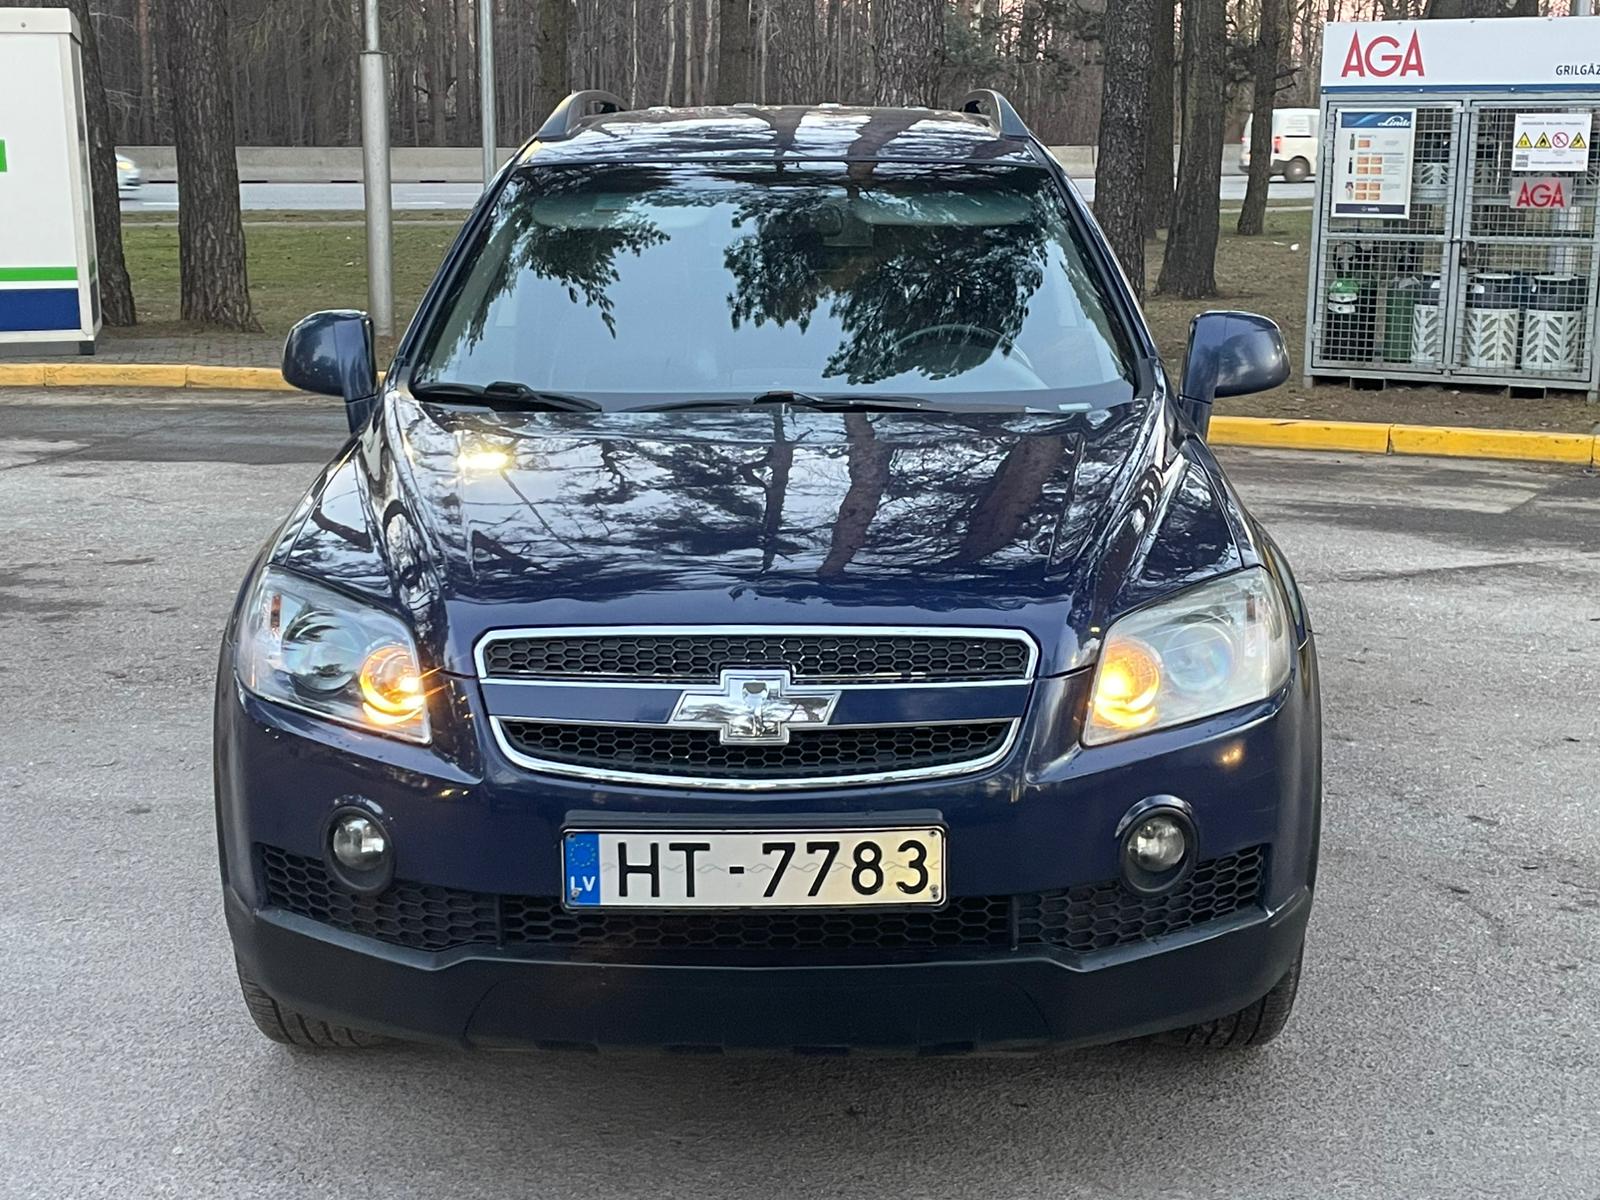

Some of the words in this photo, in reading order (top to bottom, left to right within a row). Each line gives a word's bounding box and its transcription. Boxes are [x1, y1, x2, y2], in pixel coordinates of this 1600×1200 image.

[1341, 28, 1425, 78] AGA
[1516, 181, 1565, 207] AGA
[570, 876, 596, 892] LV
[617, 840, 929, 898] HT-7783
